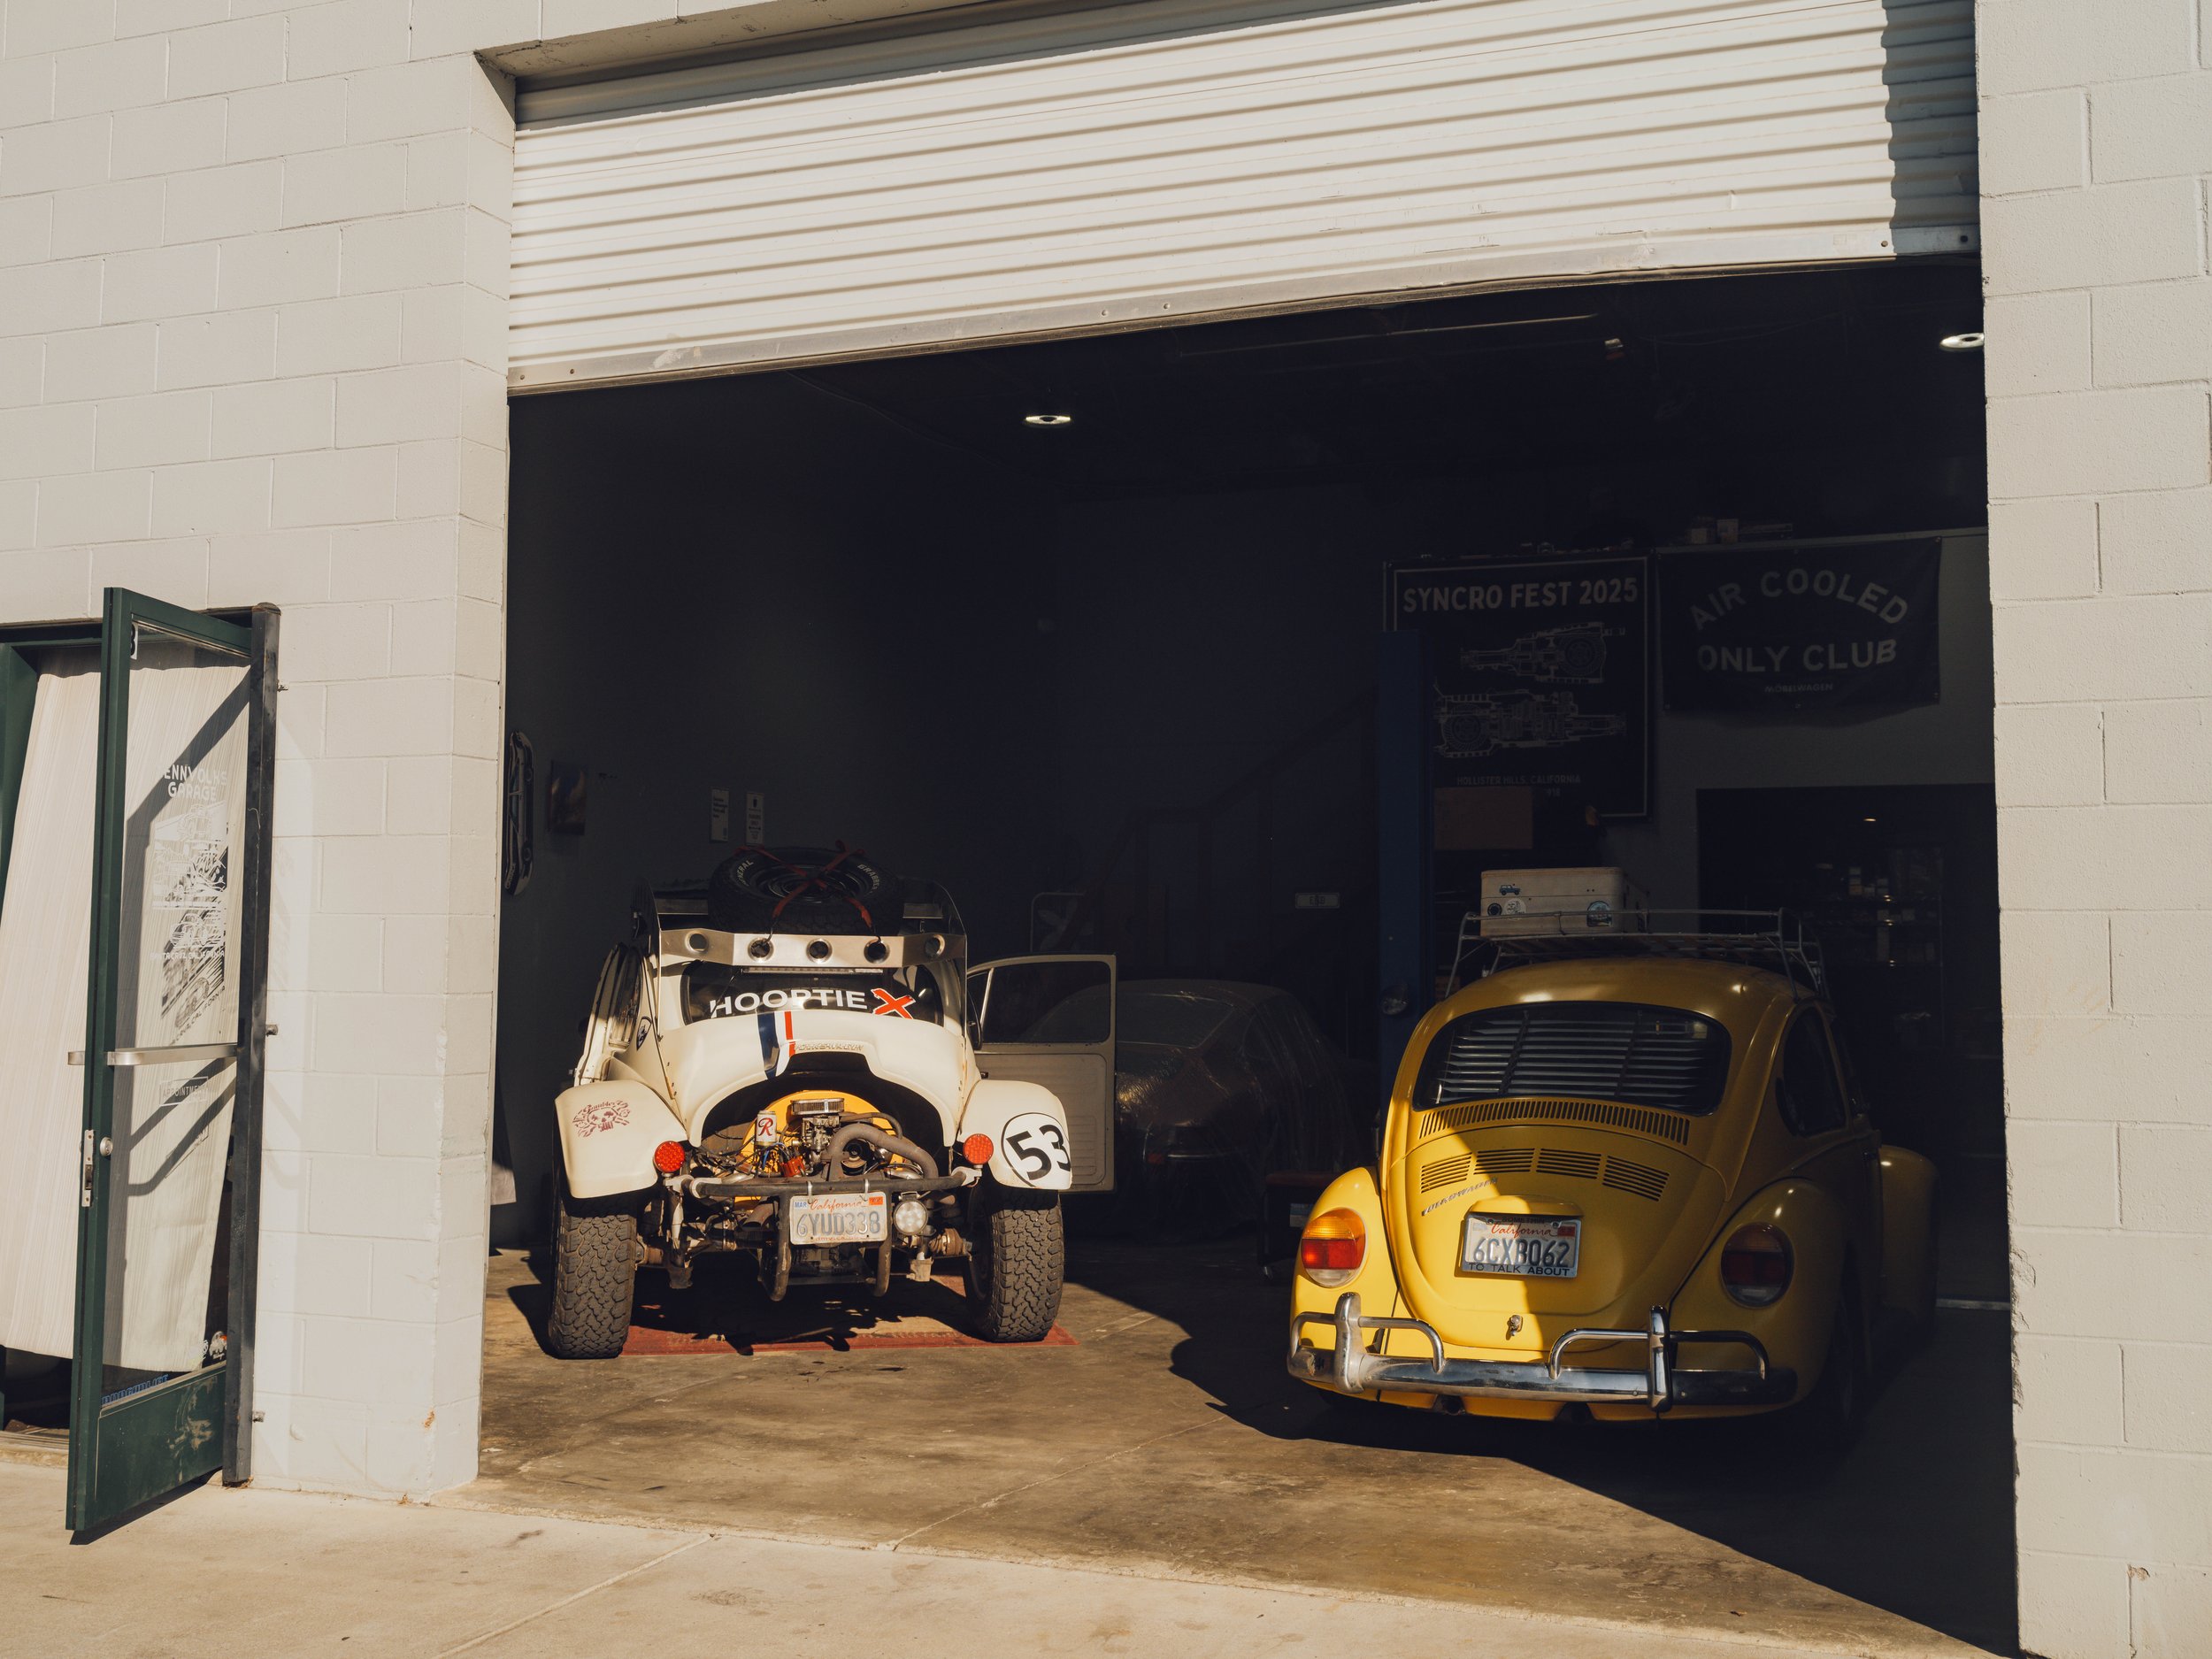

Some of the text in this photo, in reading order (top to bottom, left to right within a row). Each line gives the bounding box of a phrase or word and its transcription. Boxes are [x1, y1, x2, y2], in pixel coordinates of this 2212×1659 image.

[1402, 577, 1638, 613] SYNCRO FEST 2025
[1688, 568, 1909, 631] AIR COOLED
[1696, 638, 1897, 672] ONLY CLUB
[167, 781, 218, 803] GARAGE
[1456, 775, 1501, 786] HOLLISTER
[1530, 774, 1581, 785] CALIFORNIA
[1006, 1124, 1071, 1180] 53
[810, 1197, 863, 1212] California
[796, 1211, 881, 1237] 6YUD338
[1491, 1222, 1557, 1238] California
[1473, 1238, 1571, 1268] 6CXB062
[1469, 1263, 1570, 1277] TO TALK ABOUT
